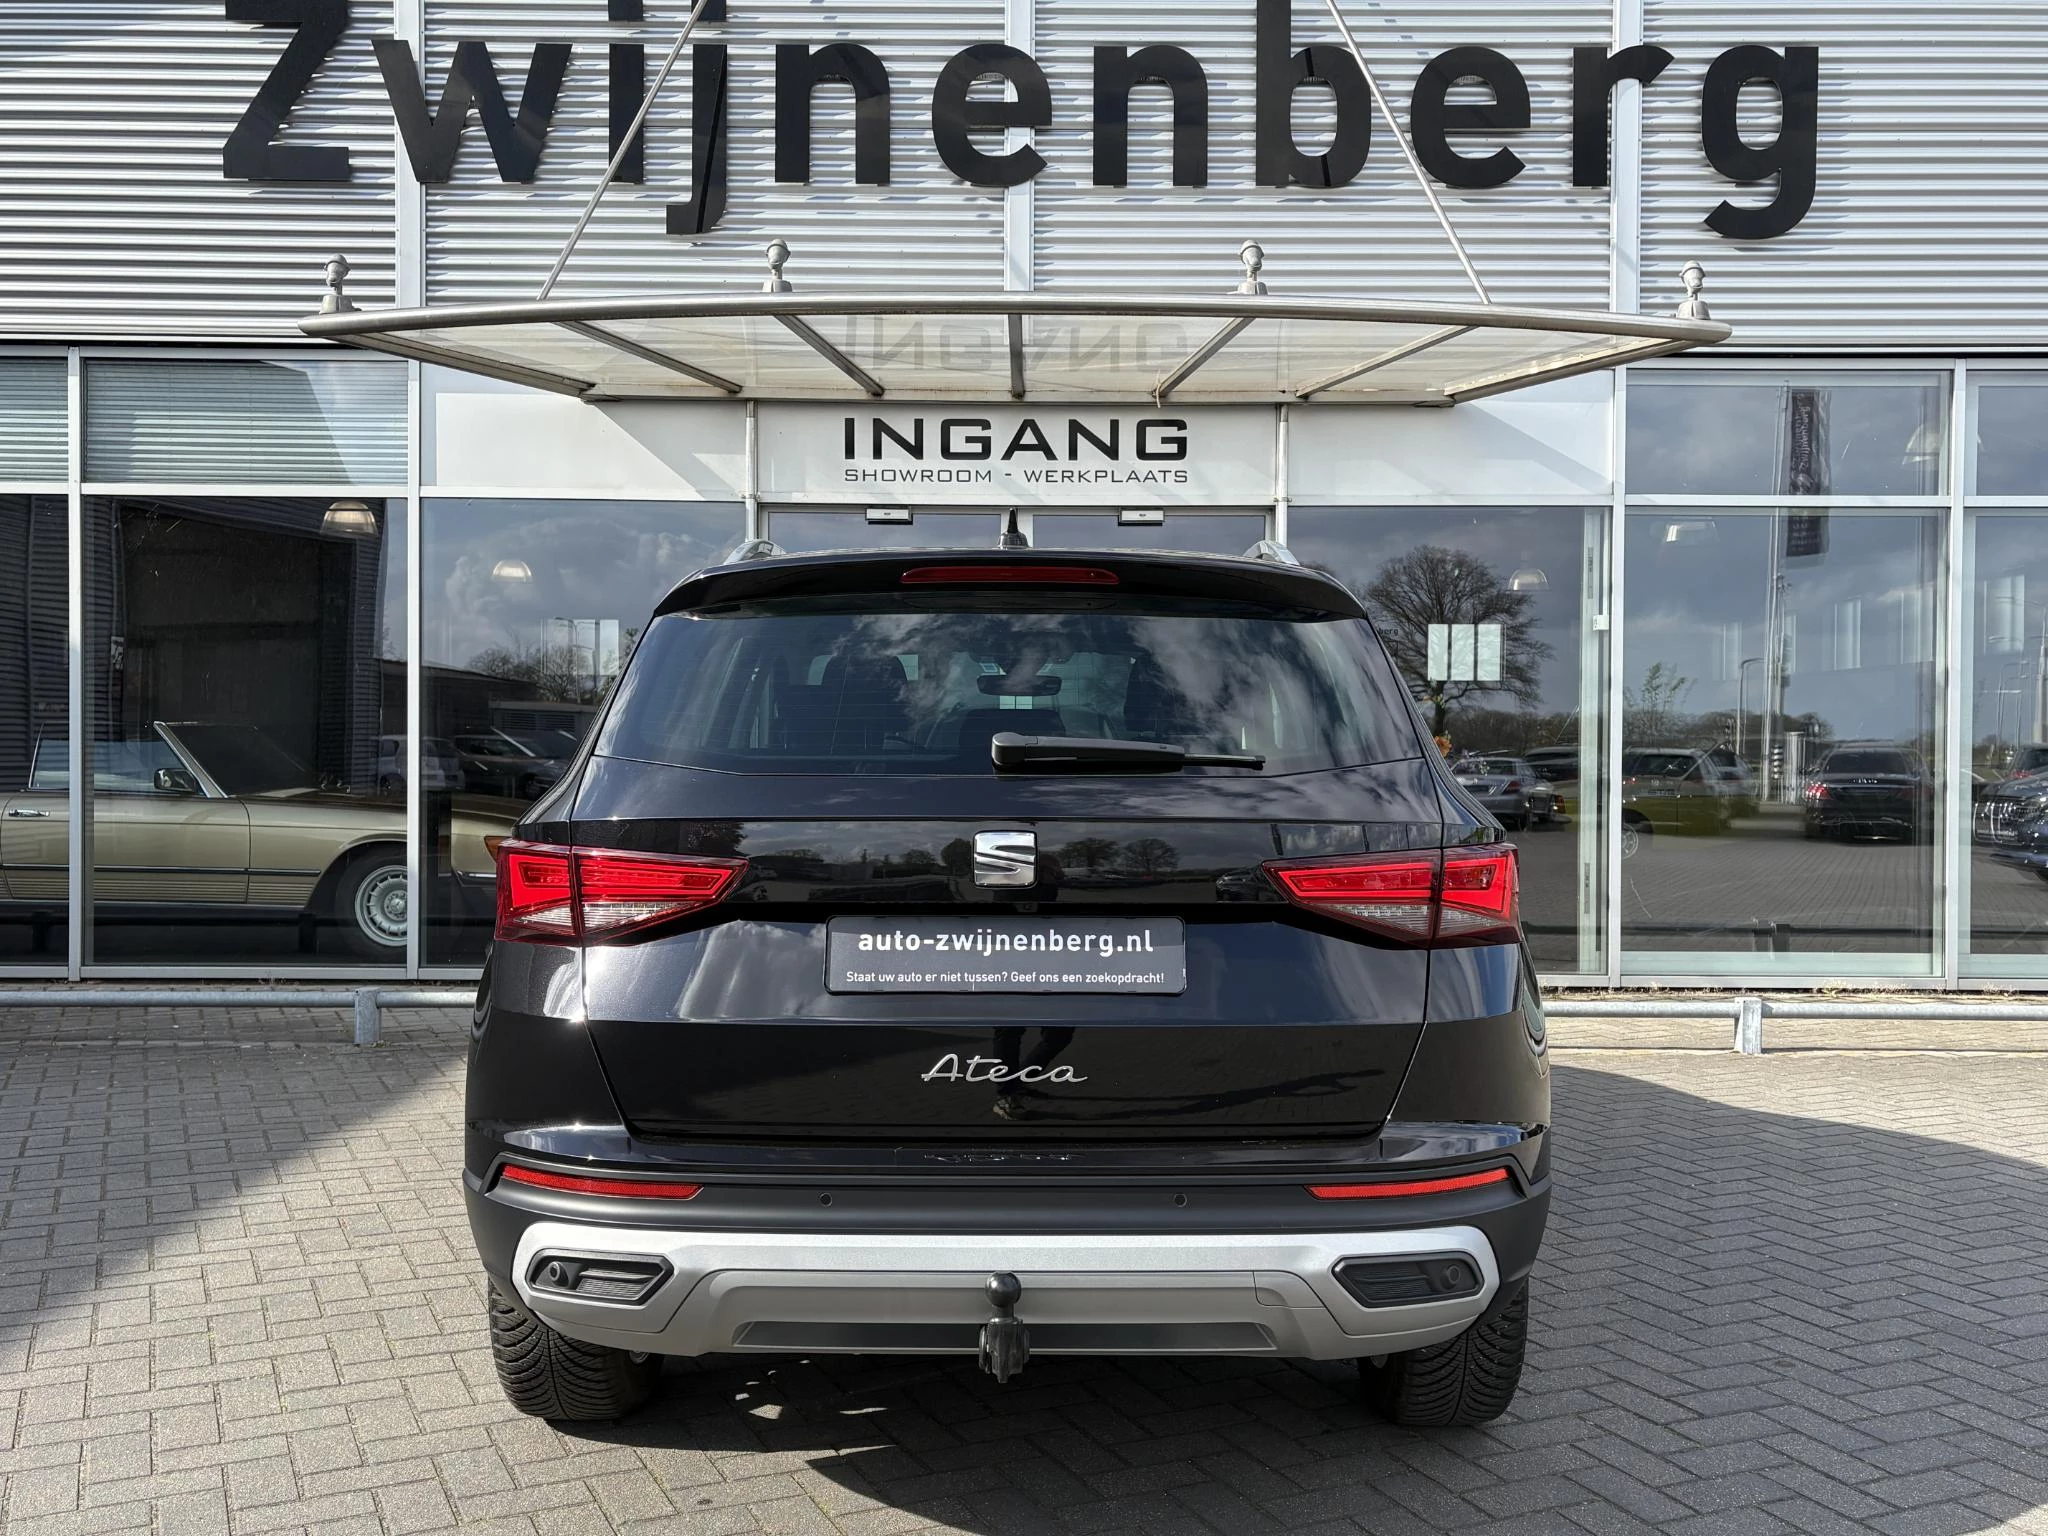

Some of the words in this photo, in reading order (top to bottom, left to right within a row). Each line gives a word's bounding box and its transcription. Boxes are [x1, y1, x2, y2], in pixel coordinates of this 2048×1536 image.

[223, 0, 1819, 240] Zwijnenberg
[844, 417, 1188, 461] INGANG
[844, 469, 992, 482] SHOWROOM
[1023, 470, 1188, 483] WERKPLAATS
[858, 928, 1154, 957] auto-zwijnenberg.nl
[846, 971, 876, 983] Staat
[879, 973, 896, 983] uw
[898, 972, 922, 983] auto
[925, 973, 938, 983] er
[940, 970, 962, 983] niet
[964, 971, 1009, 983] tussen?
[1011, 971, 1037, 984] Geef
[1039, 973, 1060, 983] ons
[1062, 973, 1083, 983] een
[1085, 971, 1165, 986] zoekopdracht!
[920, 1053, 1088, 1083] Ateca
